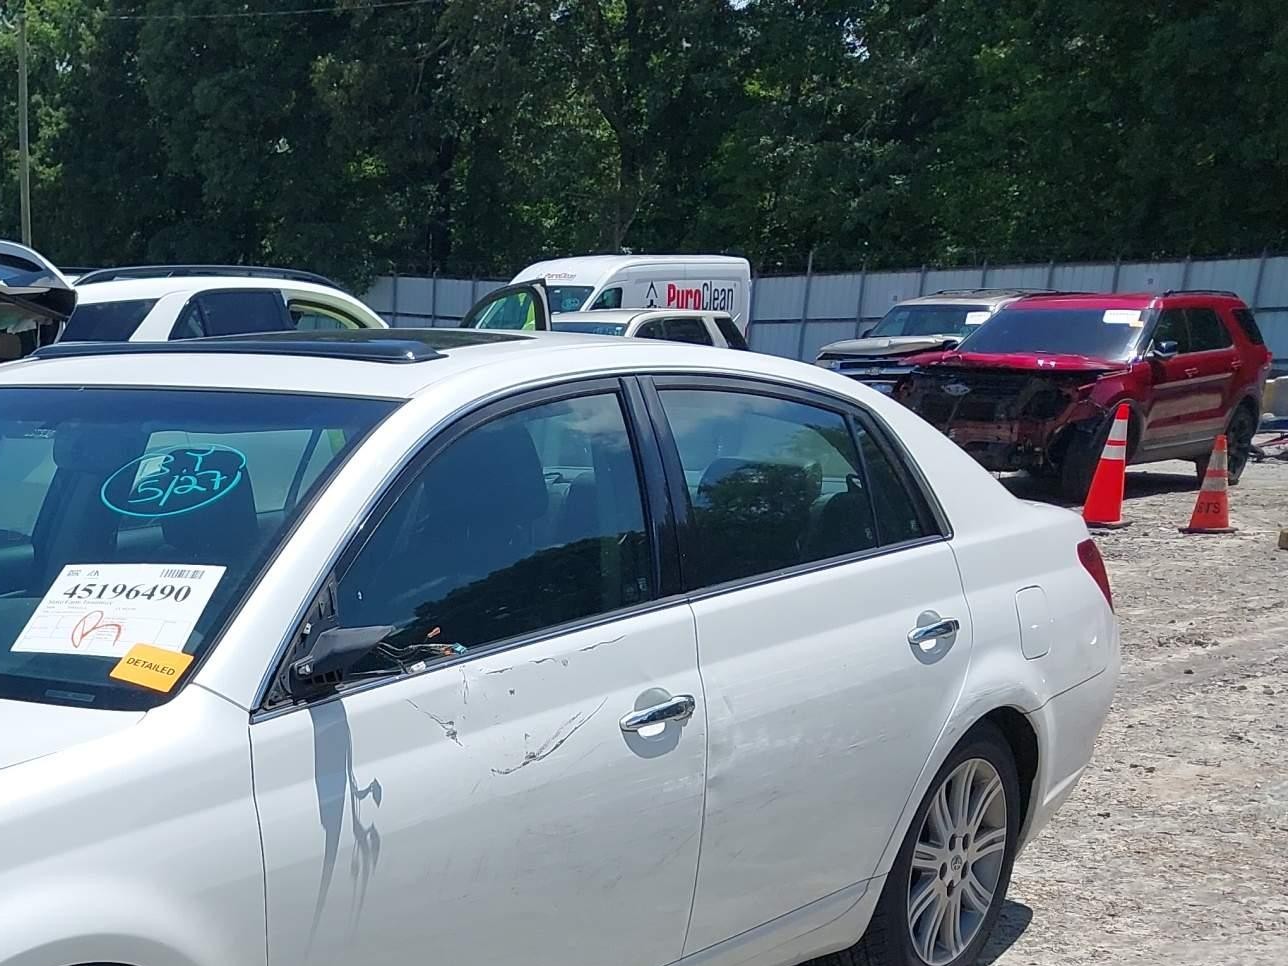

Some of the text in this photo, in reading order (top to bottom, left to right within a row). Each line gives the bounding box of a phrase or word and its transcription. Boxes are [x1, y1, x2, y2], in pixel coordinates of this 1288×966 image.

[667, 280, 734, 311] PuroClean
[127, 470, 228, 507] 5/27
[64, 583, 192, 603] 45196490
[126, 657, 176, 676] DETAILED
